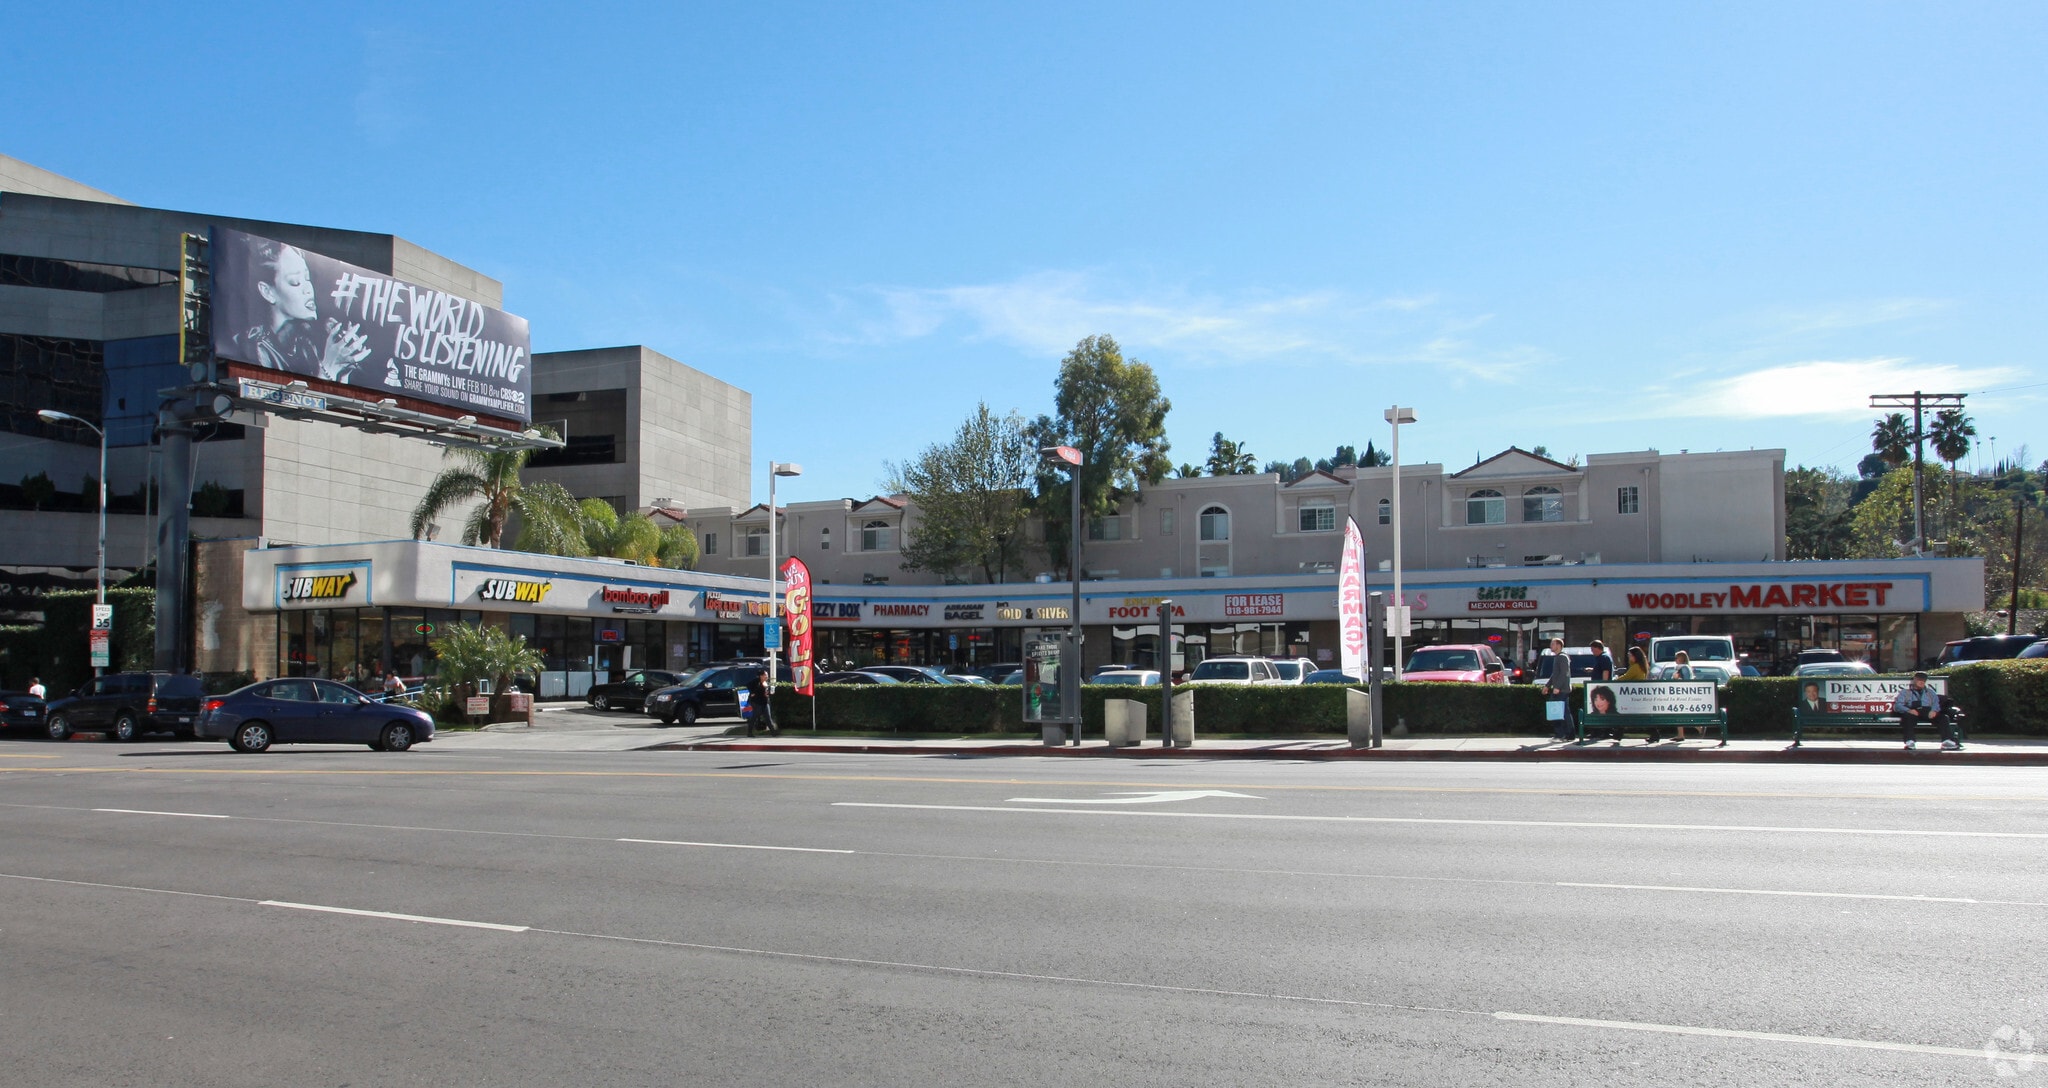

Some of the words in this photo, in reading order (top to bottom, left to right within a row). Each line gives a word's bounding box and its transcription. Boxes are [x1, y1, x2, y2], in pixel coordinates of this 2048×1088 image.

[419, 328, 525, 383] LISTENING
[404, 364, 418, 379] THE
[452, 375, 466, 391] LIVE
[467, 379, 480, 393] FEB
[480, 382, 488, 395] 10
[404, 378, 423, 393] SHARE
[424, 382, 440, 396] YOUR
[440, 387, 460, 400] SOUND
[460, 391, 469, 402] ON
[248, 386, 322, 408] REGENCY
[282, 574, 352, 599] SUBWAY
[482, 579, 552, 602] SUBWAY
[602, 586, 649, 604] bamboo
[650, 590, 670, 608] grill
[1226, 595, 1248, 606] FOR
[1249, 594, 1282, 606] LEASE
[1627, 593, 1727, 609] WOODLEY
[1729, 583, 1893, 608] MARKET
[838, 603, 861, 618] BOX
[873, 604, 930, 617] PHARMACY
[1226, 605, 1282, 614] 818-981-7944
[1511, 601, 1535, 609] GRILL
[944, 611, 984, 620] BAGEL
[997, 607, 1022, 620] GOLD
[1025, 608, 1034, 619] &
[1036, 607, 1069, 619] SILVER
[1109, 606, 1150, 618] FOOT
[95, 618, 110, 628] 35
[785, 586, 811, 688] GOLD
[1619, 686, 1666, 695] MARILYN
[1668, 686, 1712, 695] BENNETT
[1831, 682, 1872, 694] DEAN
[1667, 703, 1713, 712] 469-6699
